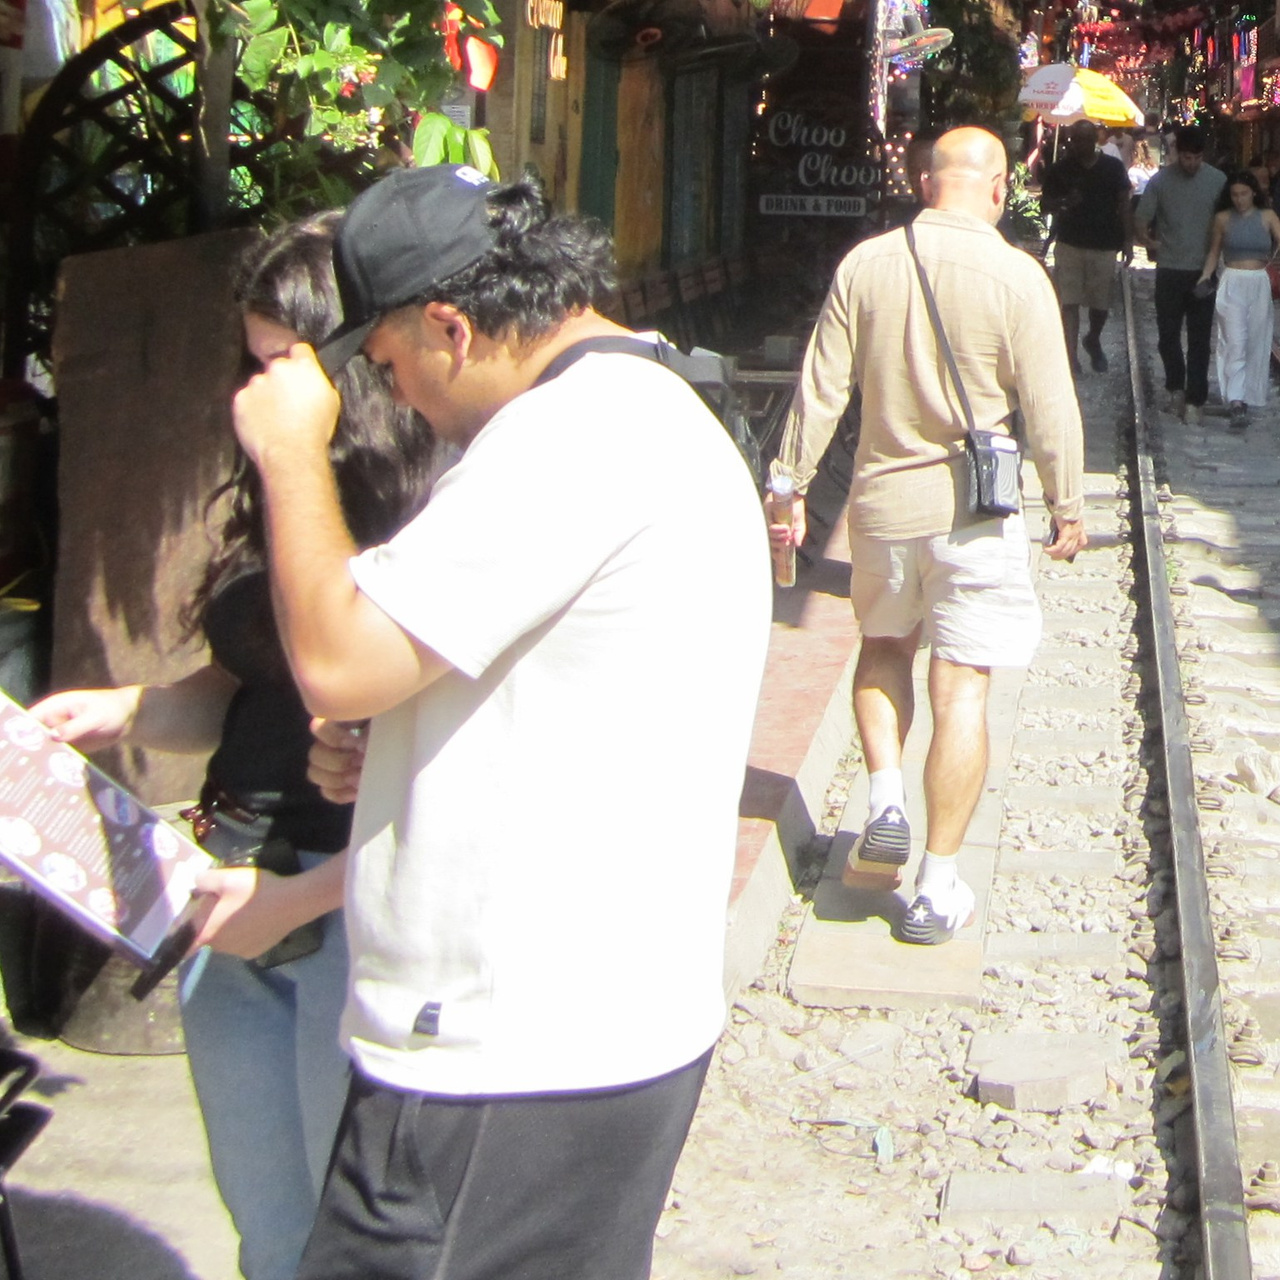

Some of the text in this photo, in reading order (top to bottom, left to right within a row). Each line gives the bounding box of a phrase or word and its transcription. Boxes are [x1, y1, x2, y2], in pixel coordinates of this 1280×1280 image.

[769, 111, 846, 148] Choo
[798, 151, 876, 188] Choo
[764, 197, 863, 215] DRINK & FOOD
